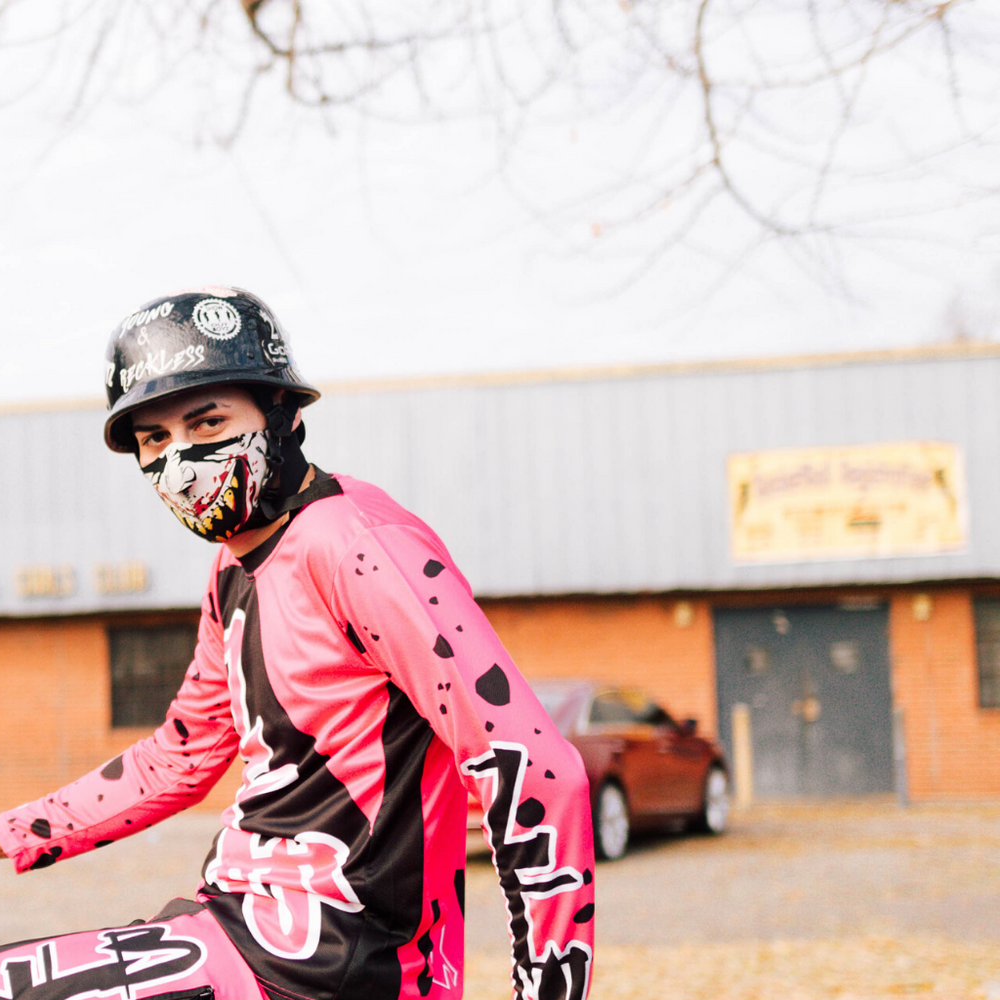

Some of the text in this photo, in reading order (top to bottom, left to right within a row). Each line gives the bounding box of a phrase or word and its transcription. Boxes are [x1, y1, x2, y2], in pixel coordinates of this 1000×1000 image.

[119, 302, 175, 339] YOUNG
[137, 327, 150, 346] &
[120, 345, 205, 393] RECKLESS
